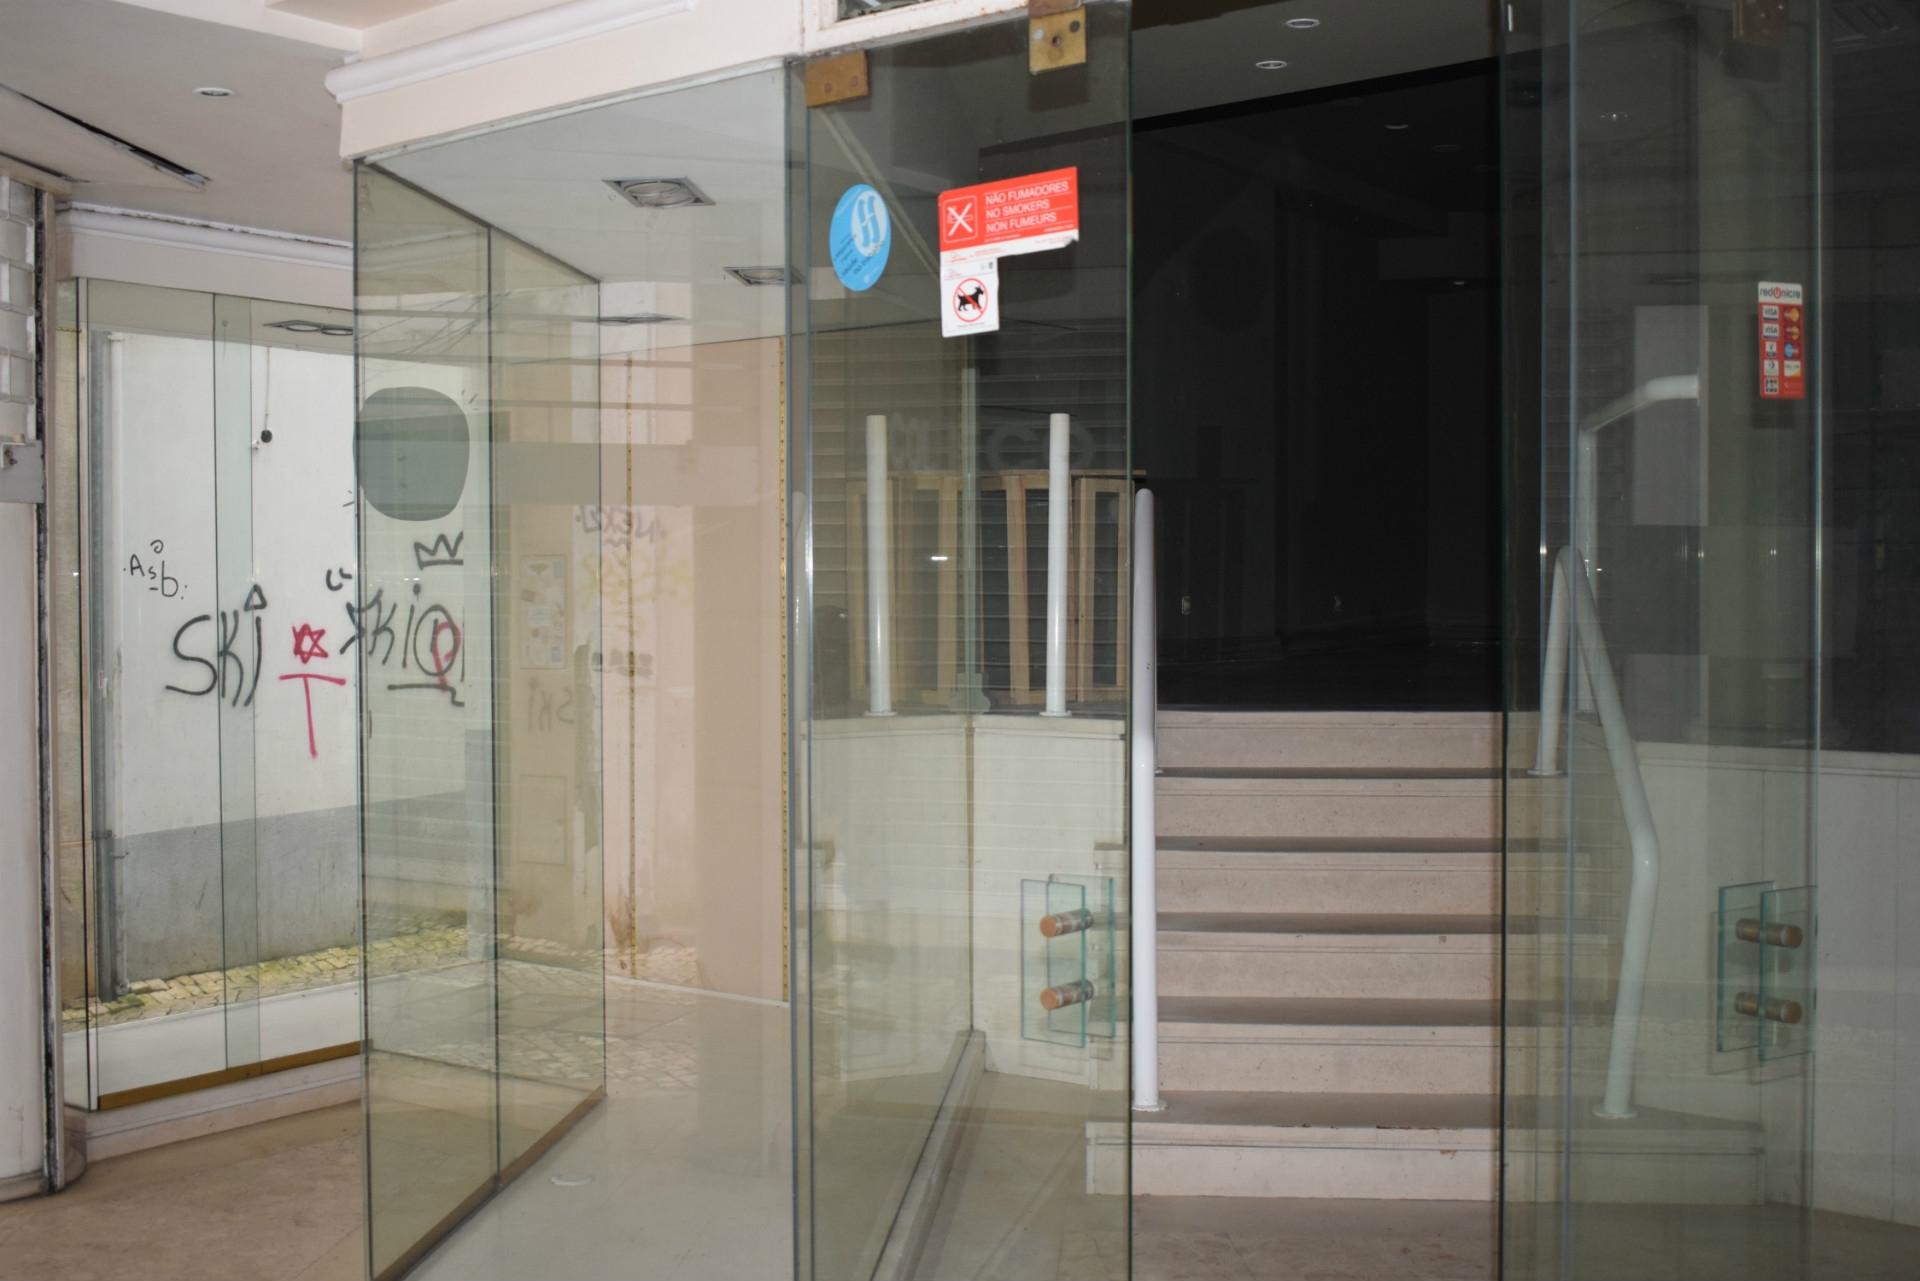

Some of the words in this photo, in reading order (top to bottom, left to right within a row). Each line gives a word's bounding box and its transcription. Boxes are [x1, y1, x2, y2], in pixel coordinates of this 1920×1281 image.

[985, 192, 1007, 206] NÃO
[1008, 181, 1069, 201] FUMADORES
[985, 207, 1001, 219] NO
[1002, 199, 1051, 217] SMOKERS
[985, 221, 1008, 233] NON
[1009, 211, 1057, 229] FUMEURS
